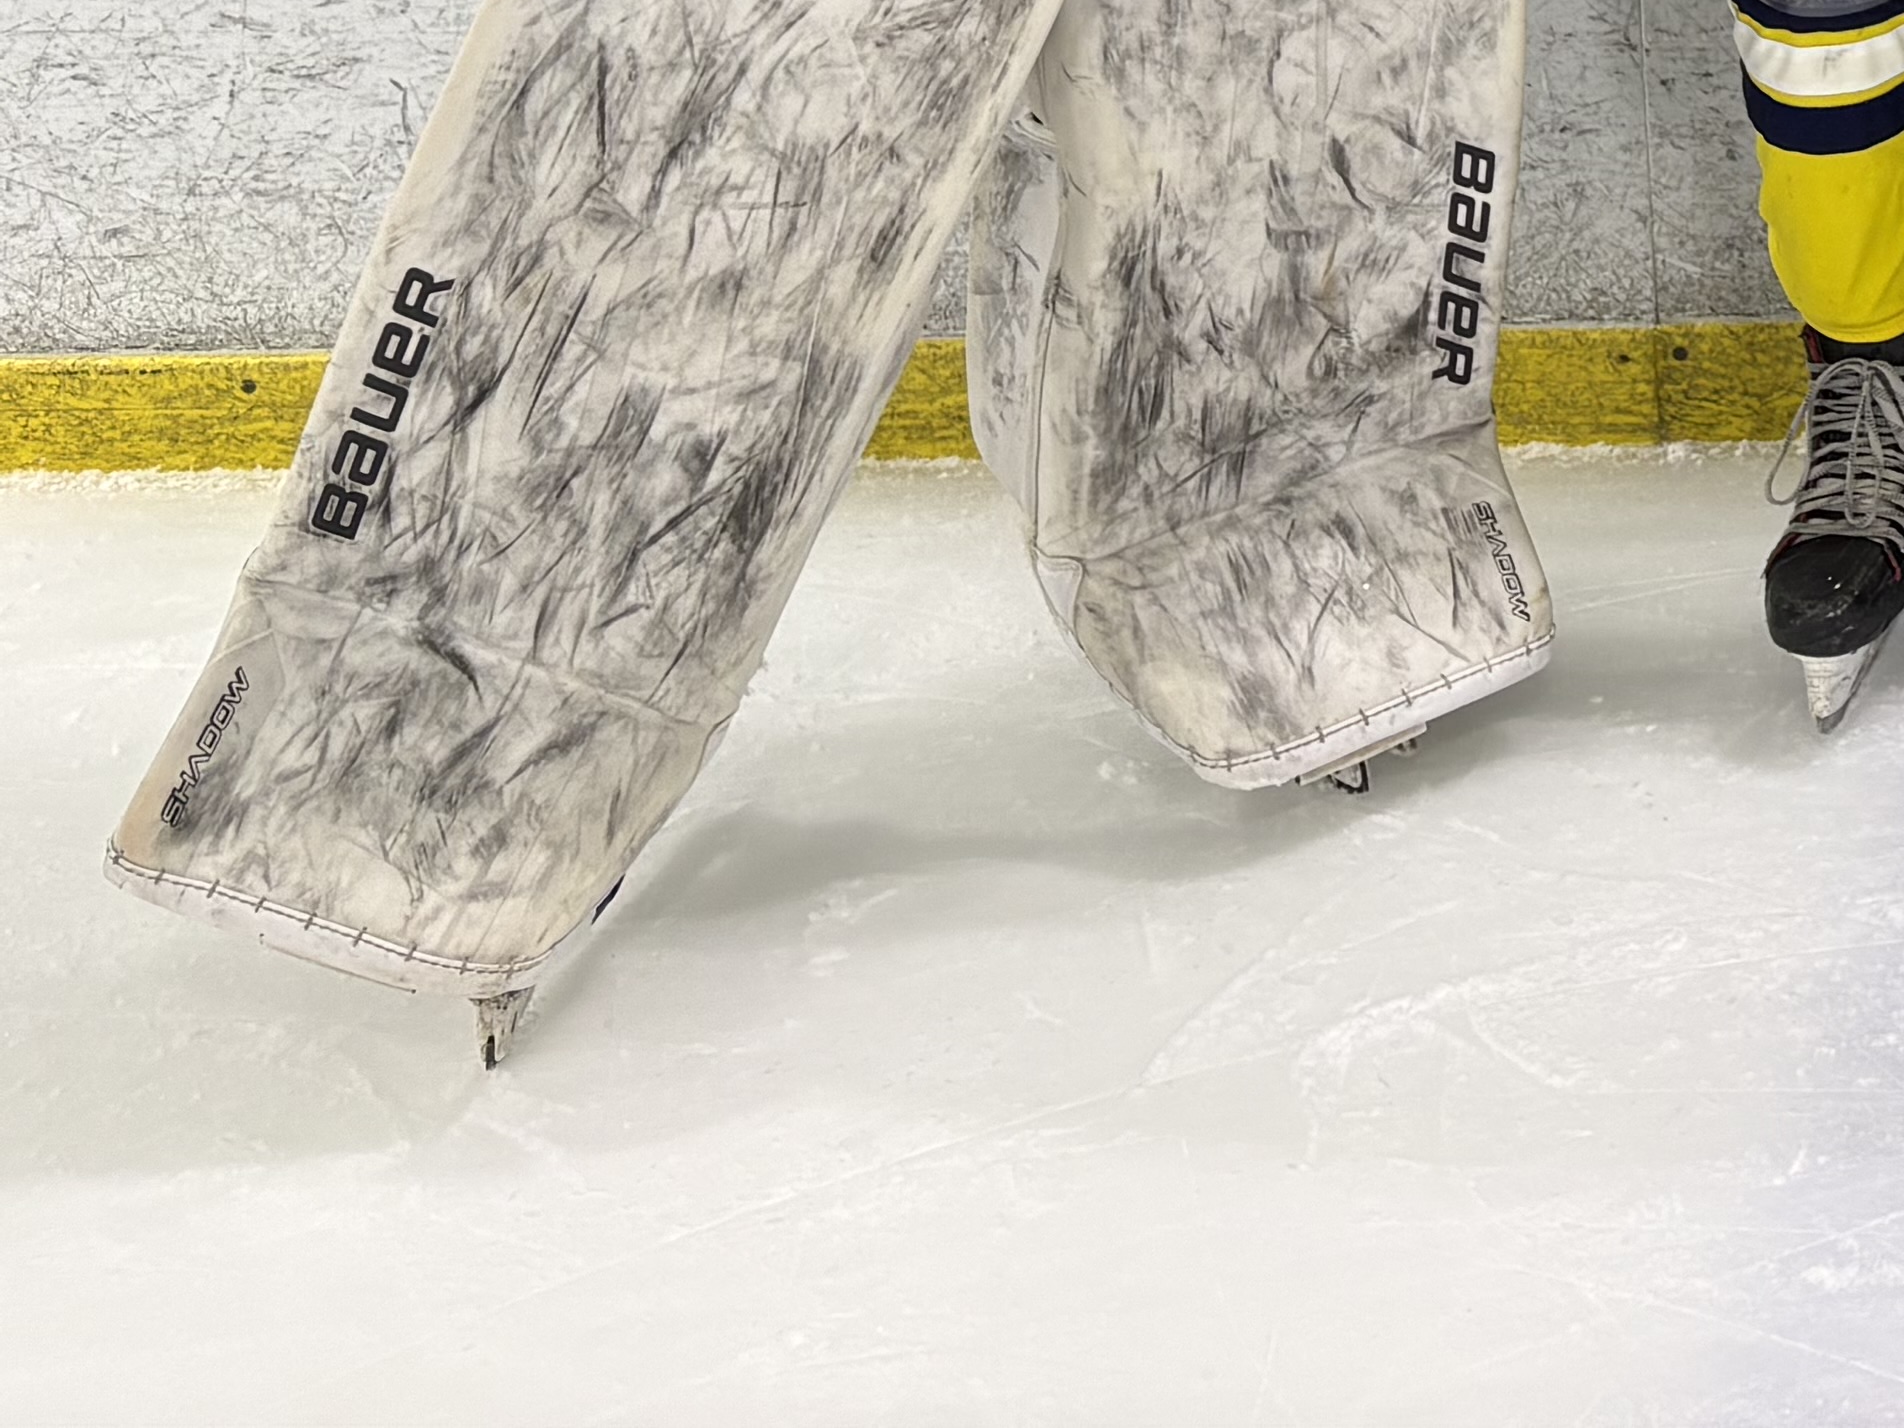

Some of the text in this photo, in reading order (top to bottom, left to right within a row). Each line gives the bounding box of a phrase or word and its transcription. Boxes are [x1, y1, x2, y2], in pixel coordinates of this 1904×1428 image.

[1431, 140, 1496, 386] BAUER
[311, 267, 454, 542] BAUER
[1471, 499, 1530, 622] SHADOW
[160, 665, 250, 828] SHADOW
